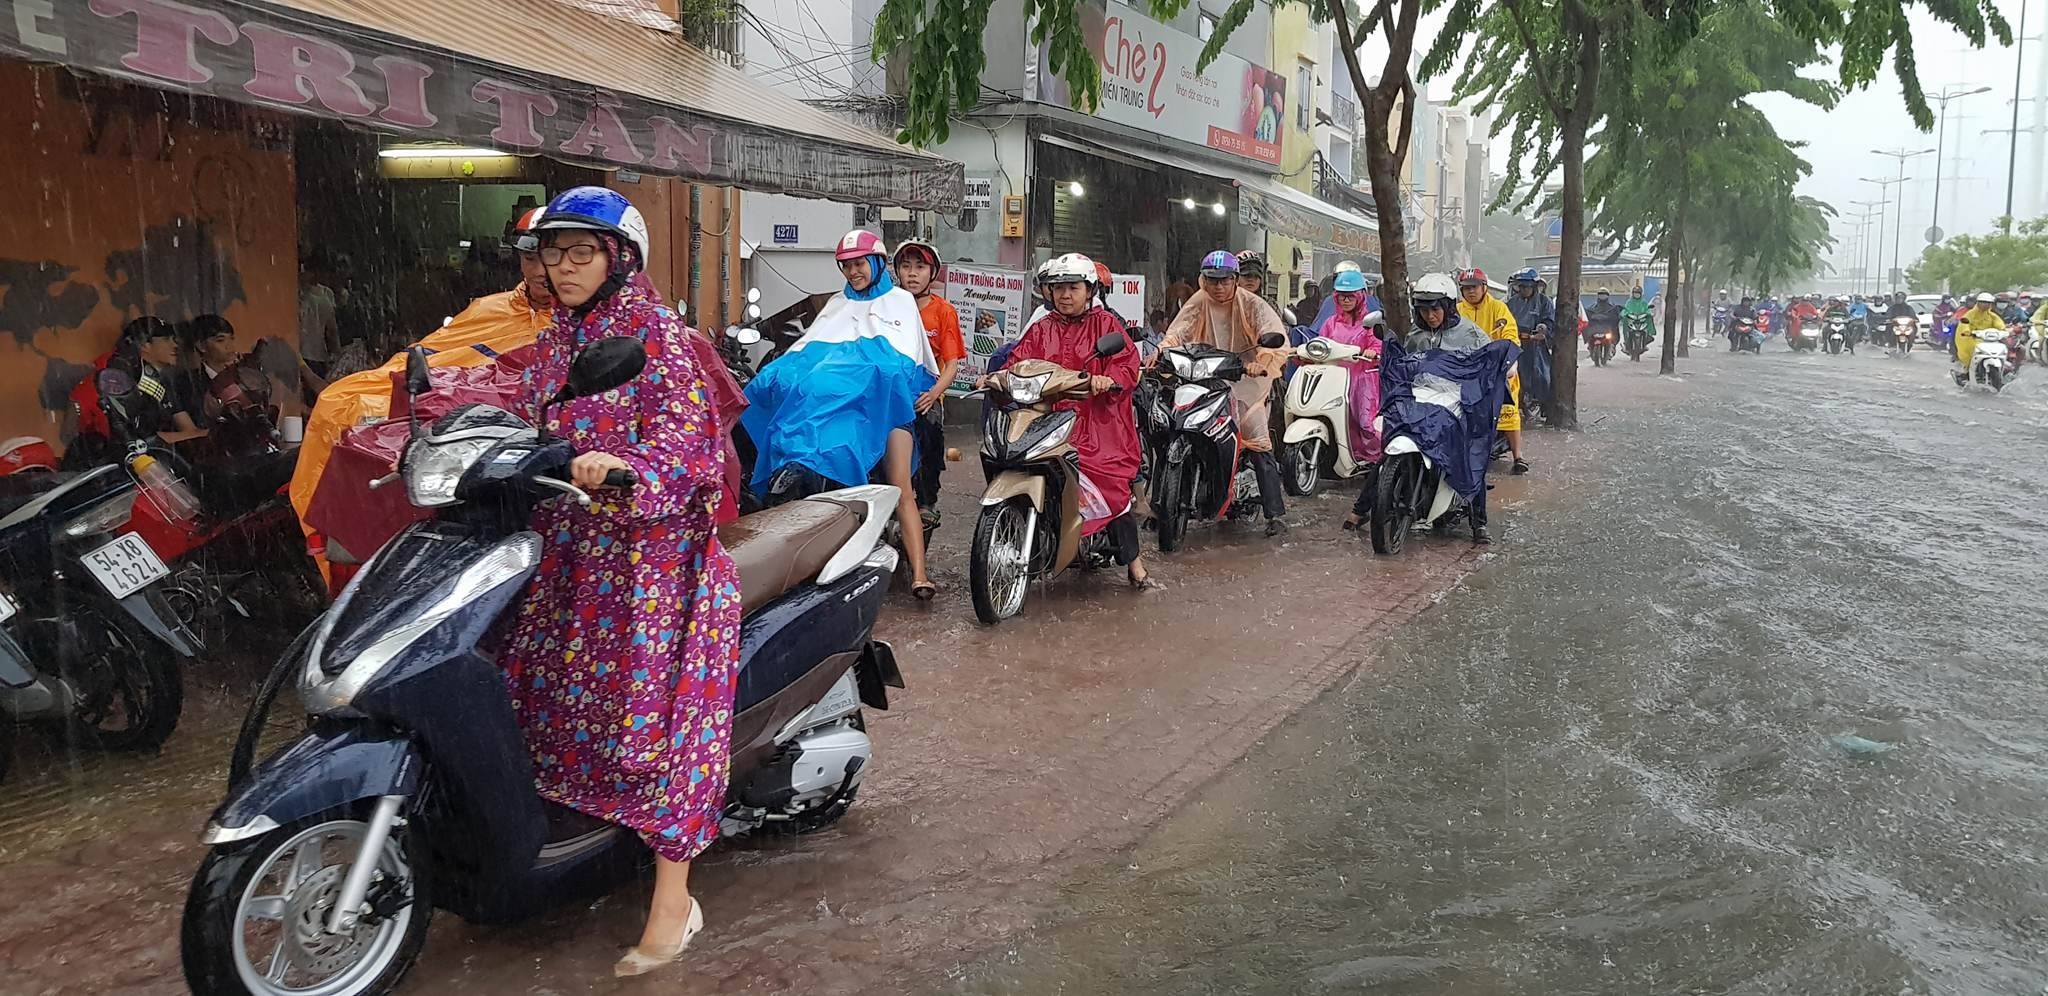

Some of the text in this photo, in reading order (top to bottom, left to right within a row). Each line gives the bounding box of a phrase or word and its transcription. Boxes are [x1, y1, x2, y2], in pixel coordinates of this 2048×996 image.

[1101, 16, 1167, 119] Chè 2
[1119, 86, 1144, 109] TRUNG
[471, 78, 717, 176] TÂN
[775, 226, 797, 238] 427/1
[949, 269, 1023, 291] BÁNH TRỨNG GÀ NON
[1122, 281, 1140, 295] 10K
[111, 557, 159, 592] 4624
[844, 575, 880, 603] LEAD
